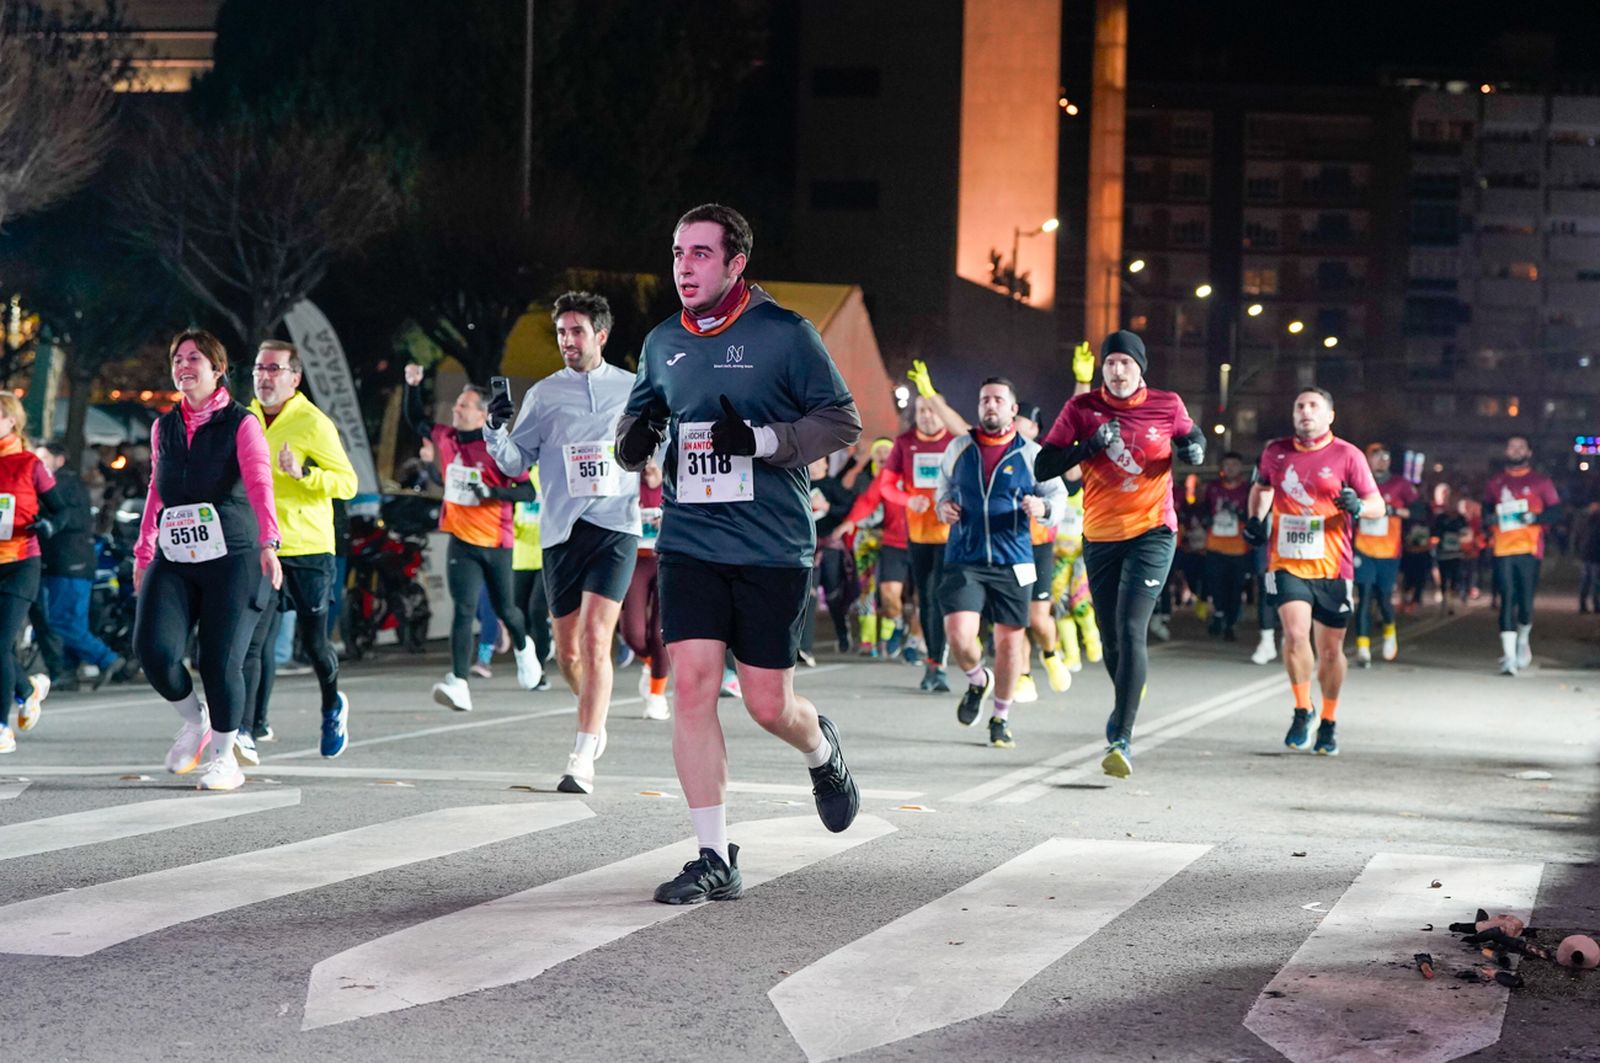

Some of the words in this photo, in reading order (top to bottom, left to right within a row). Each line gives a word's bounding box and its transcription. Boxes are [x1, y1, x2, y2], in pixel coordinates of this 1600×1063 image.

[579, 461, 610, 478] 5517
[687, 451, 732, 475] 3118
[170, 525, 209, 545] 5518
[1286, 531, 1315, 545] 1096
